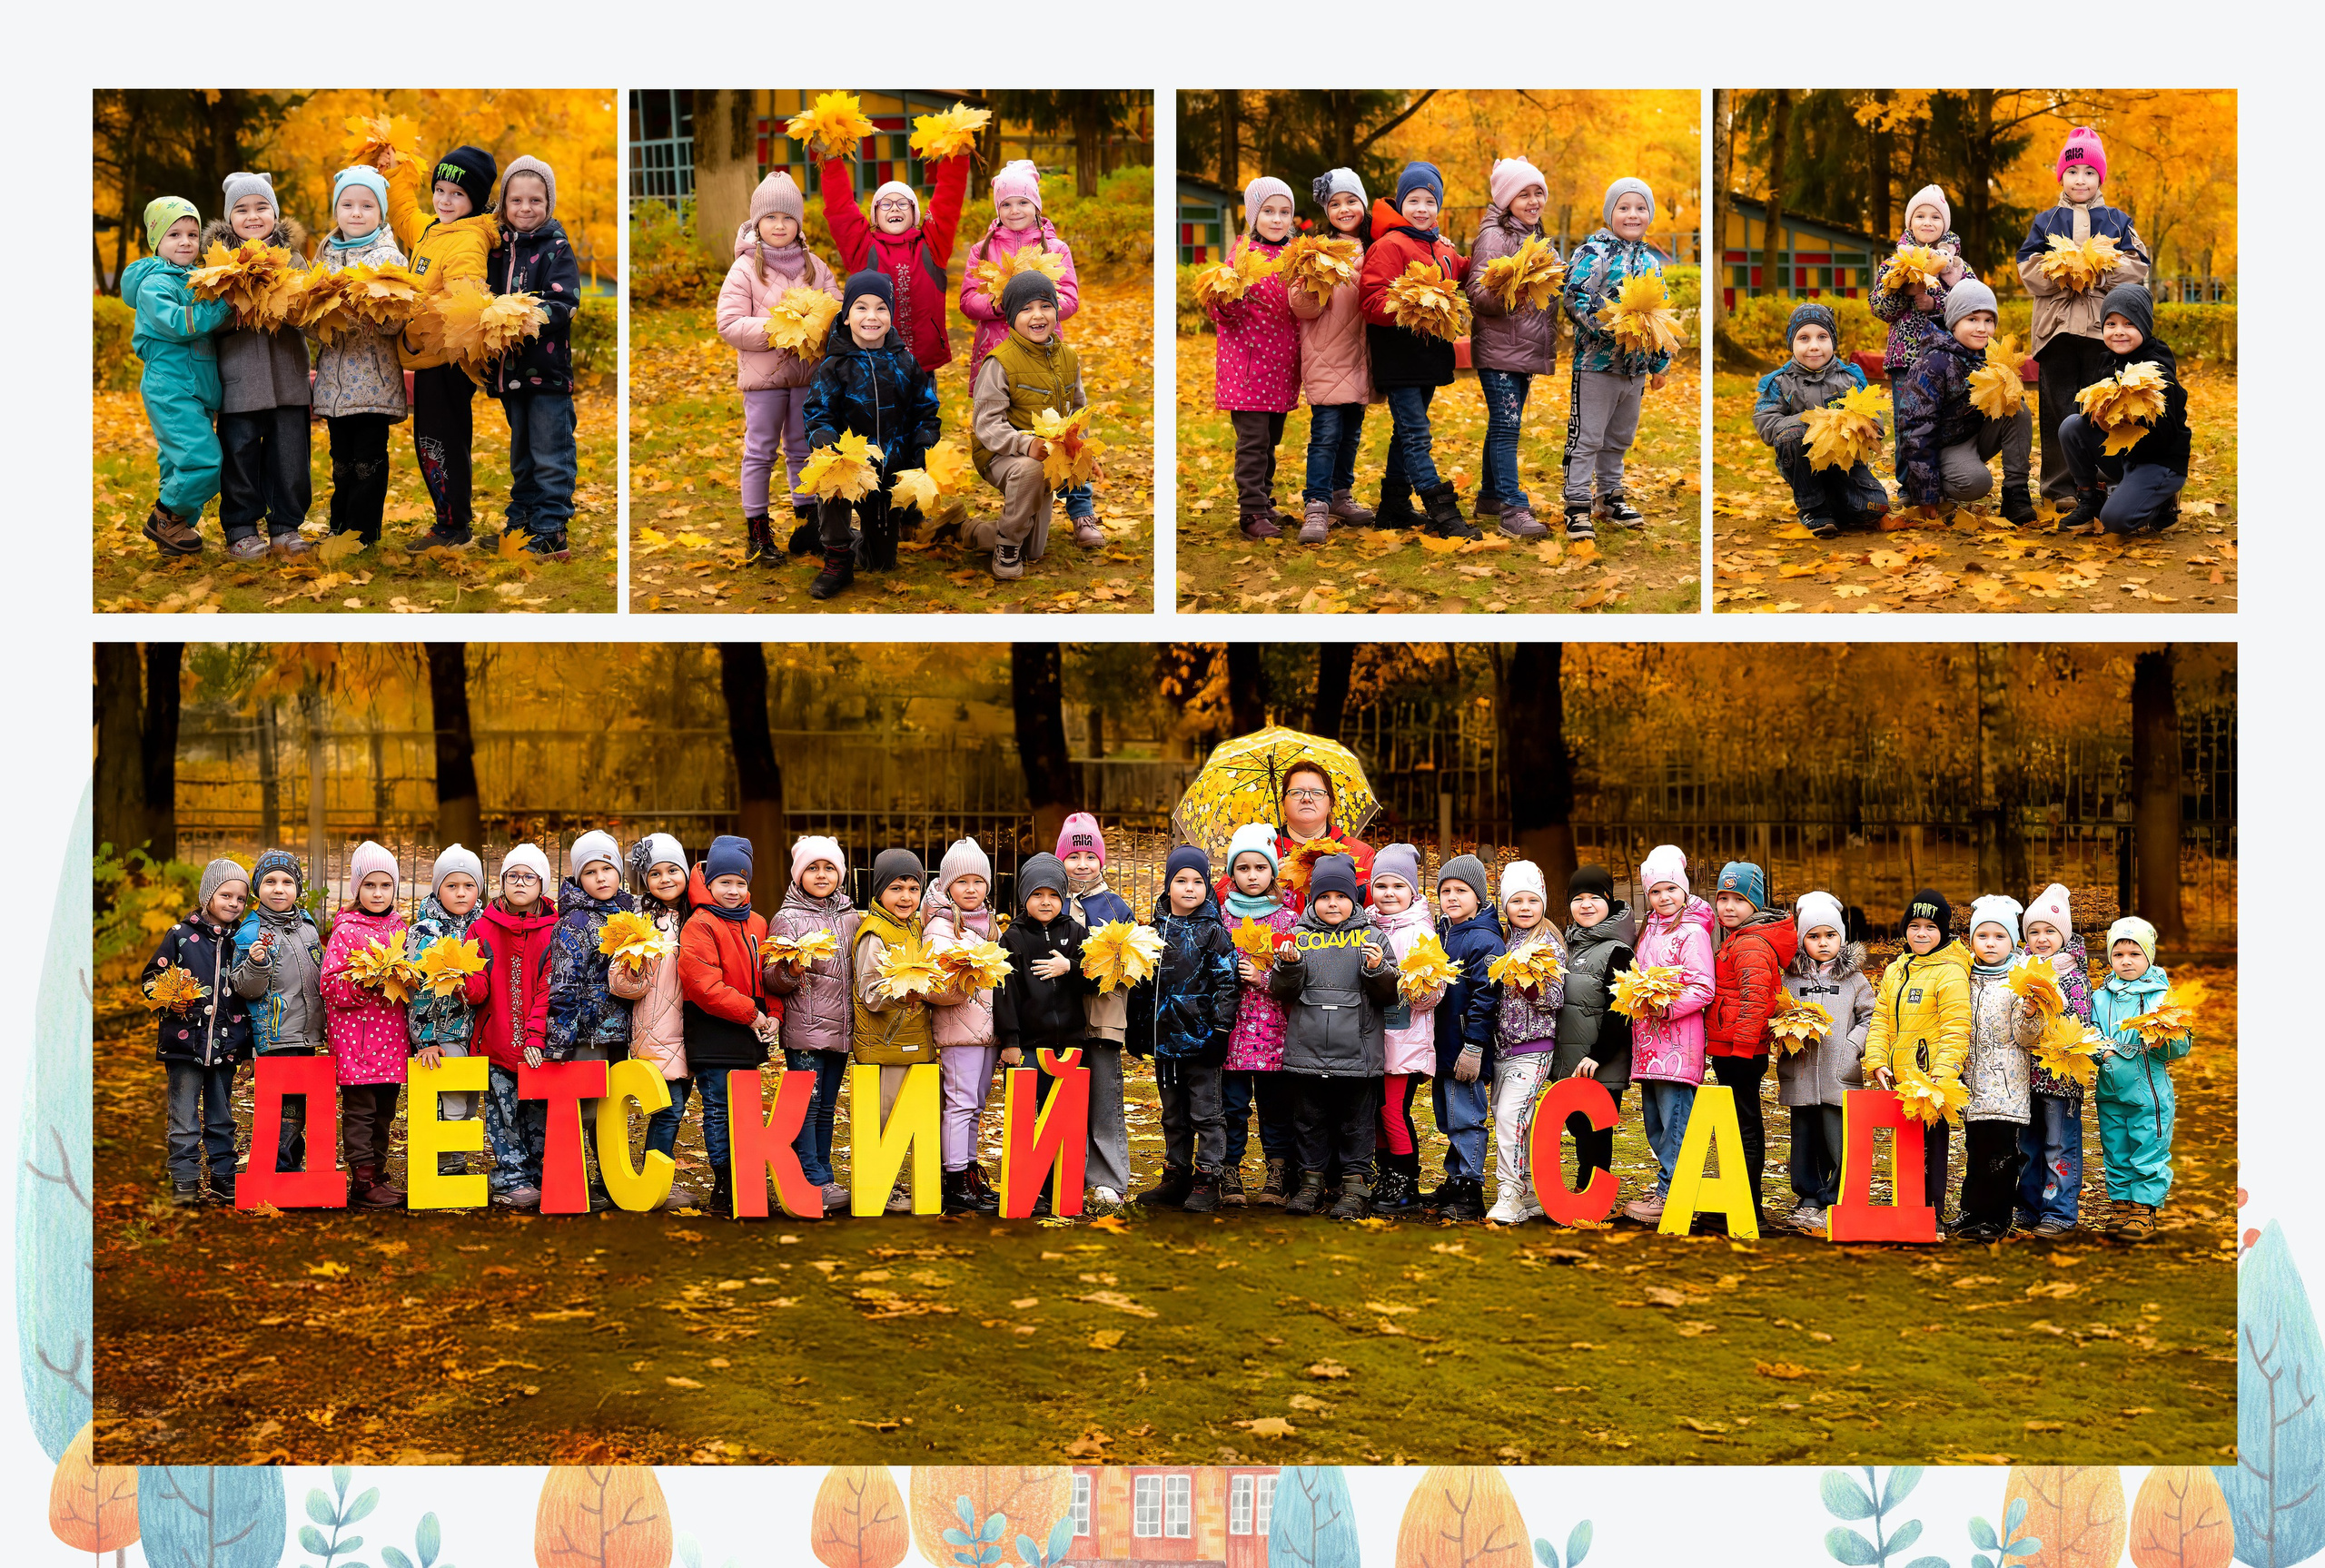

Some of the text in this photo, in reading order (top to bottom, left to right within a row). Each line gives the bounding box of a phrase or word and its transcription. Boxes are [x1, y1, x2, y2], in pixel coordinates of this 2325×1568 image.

[437, 163, 466, 183] SPORT
[1913, 902, 1938, 919] SPORT
[1258, 932, 1272, 952] Я
[234, 1047, 1937, 1244] ДЕТСКИЙ САД
